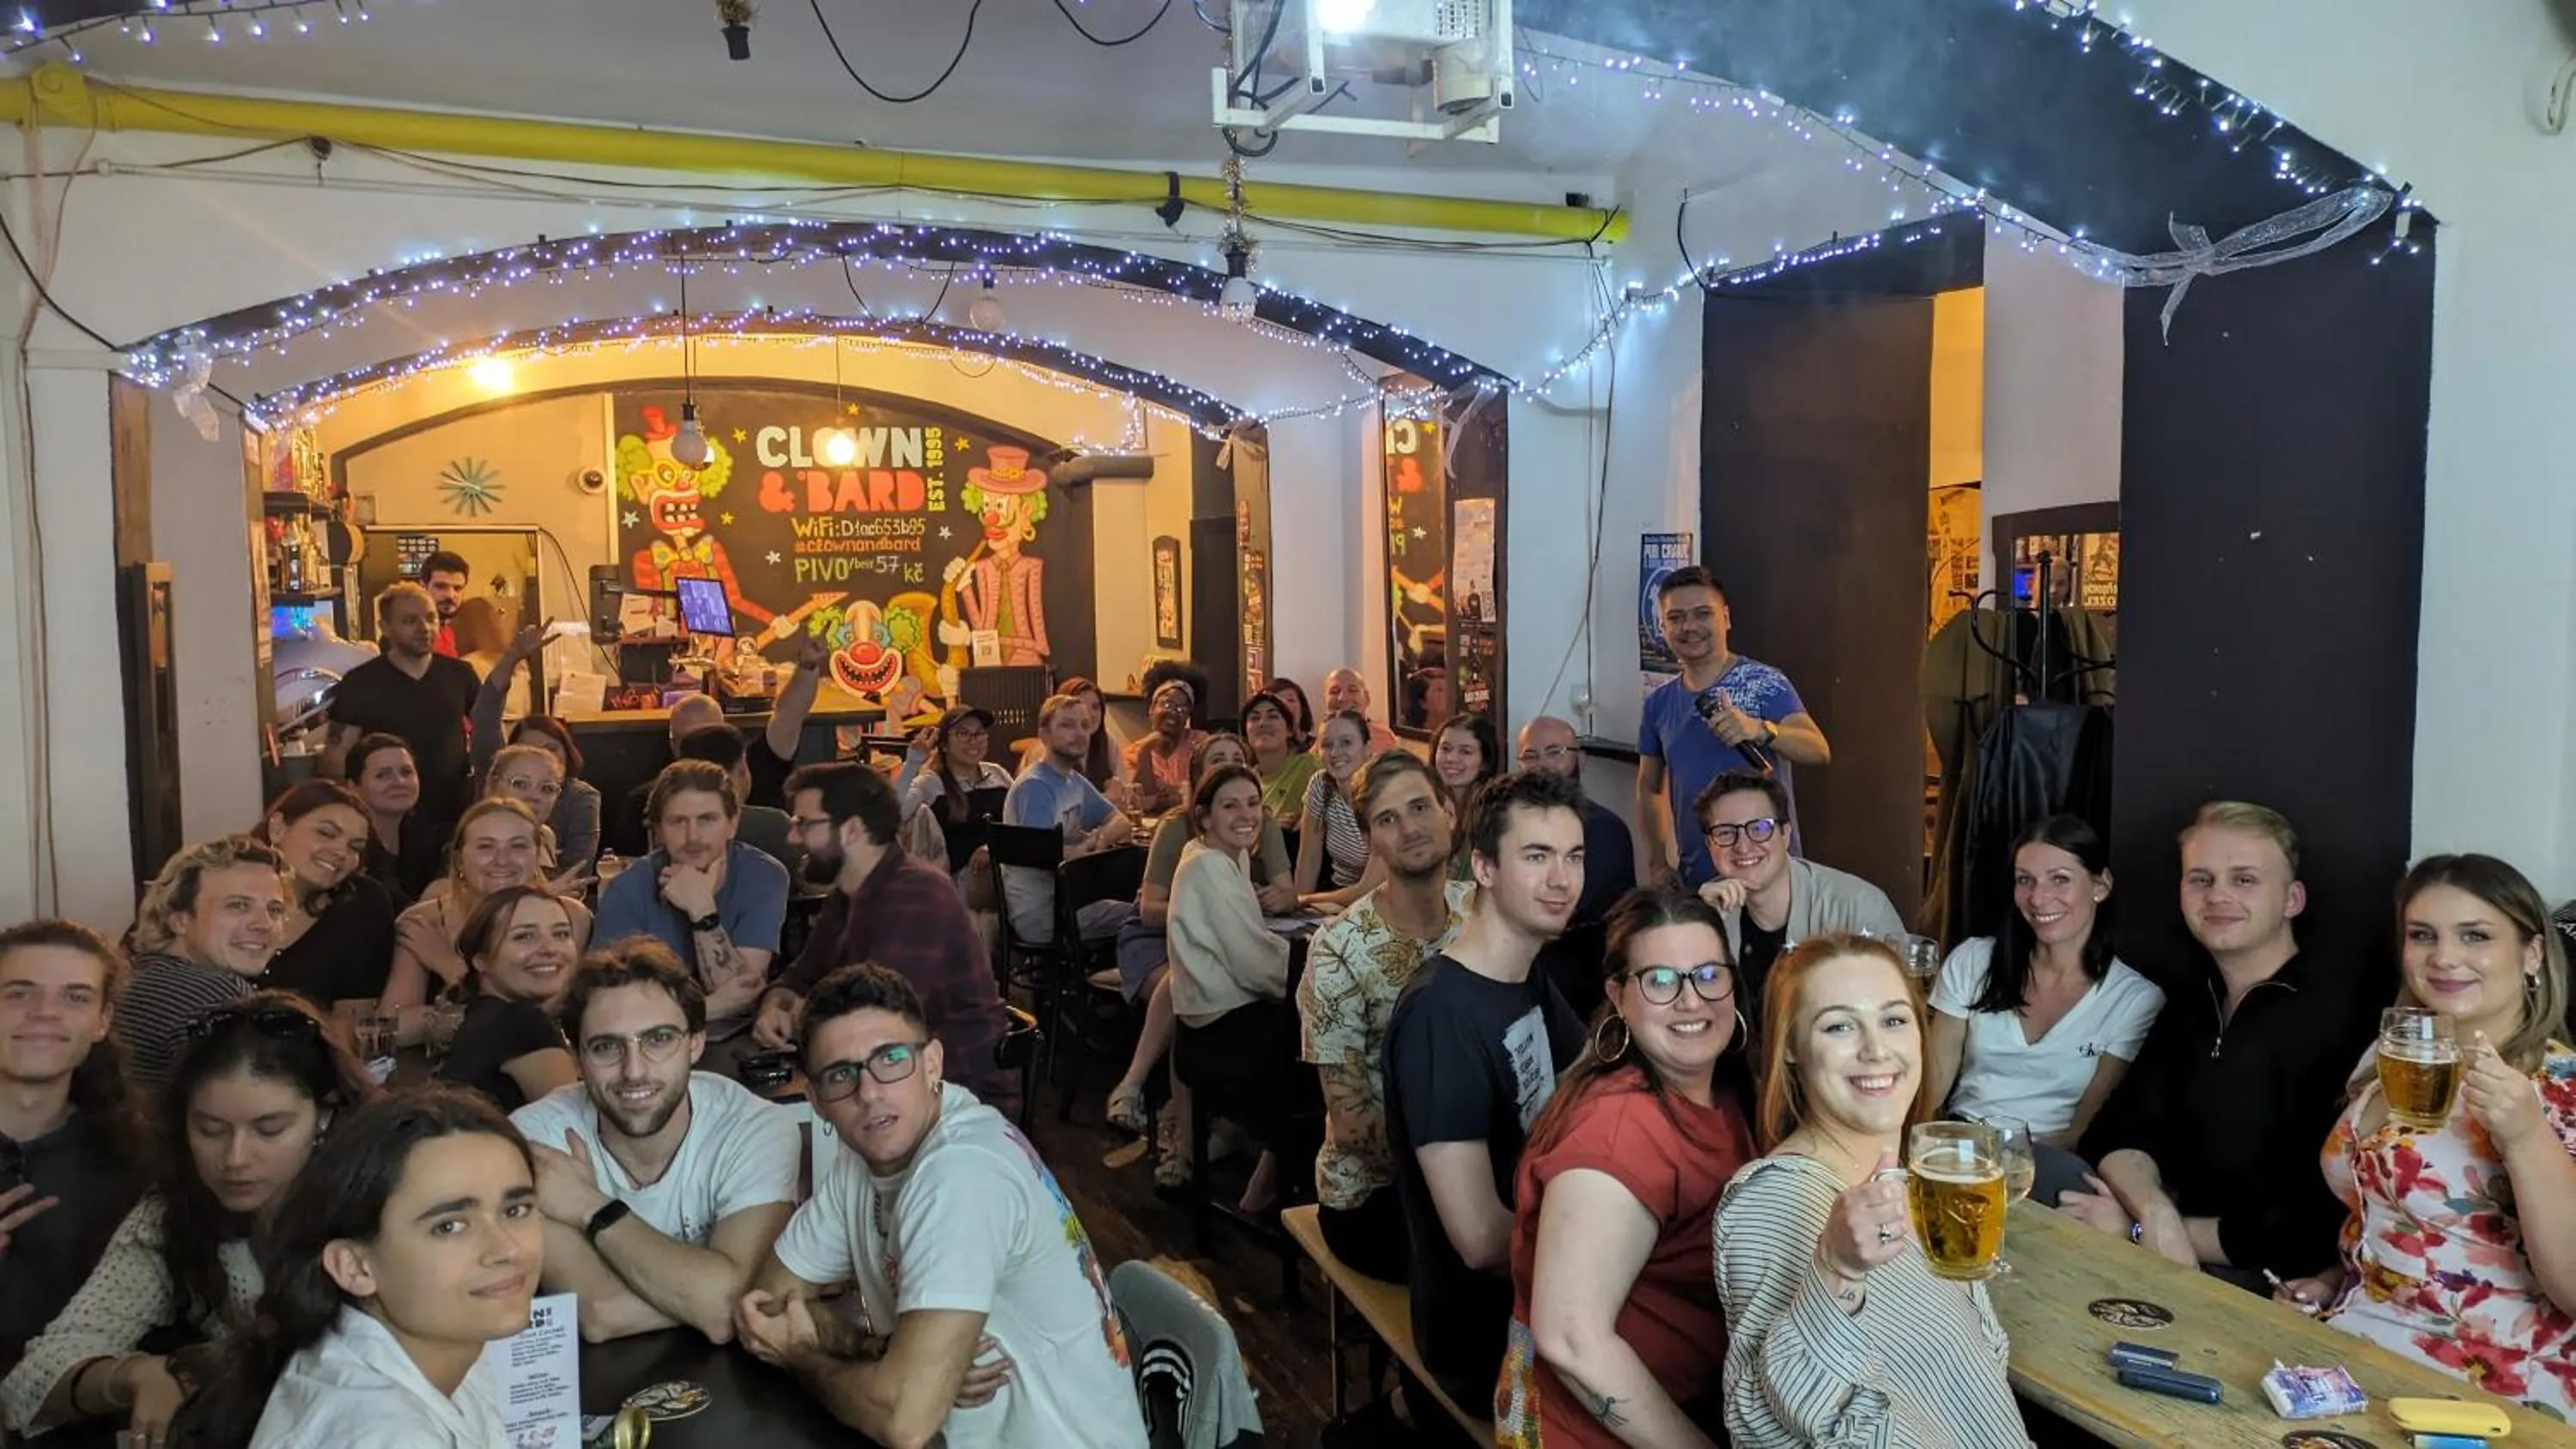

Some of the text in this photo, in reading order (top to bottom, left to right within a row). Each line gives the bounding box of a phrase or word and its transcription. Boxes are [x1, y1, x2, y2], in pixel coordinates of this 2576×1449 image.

[756, 427, 923, 468] CLOWN
[926, 427, 945, 512] EST. 1995
[760, 470, 925, 512] & BARD
[794, 557, 849, 583] PIVO
[875, 555, 899, 573] 57
